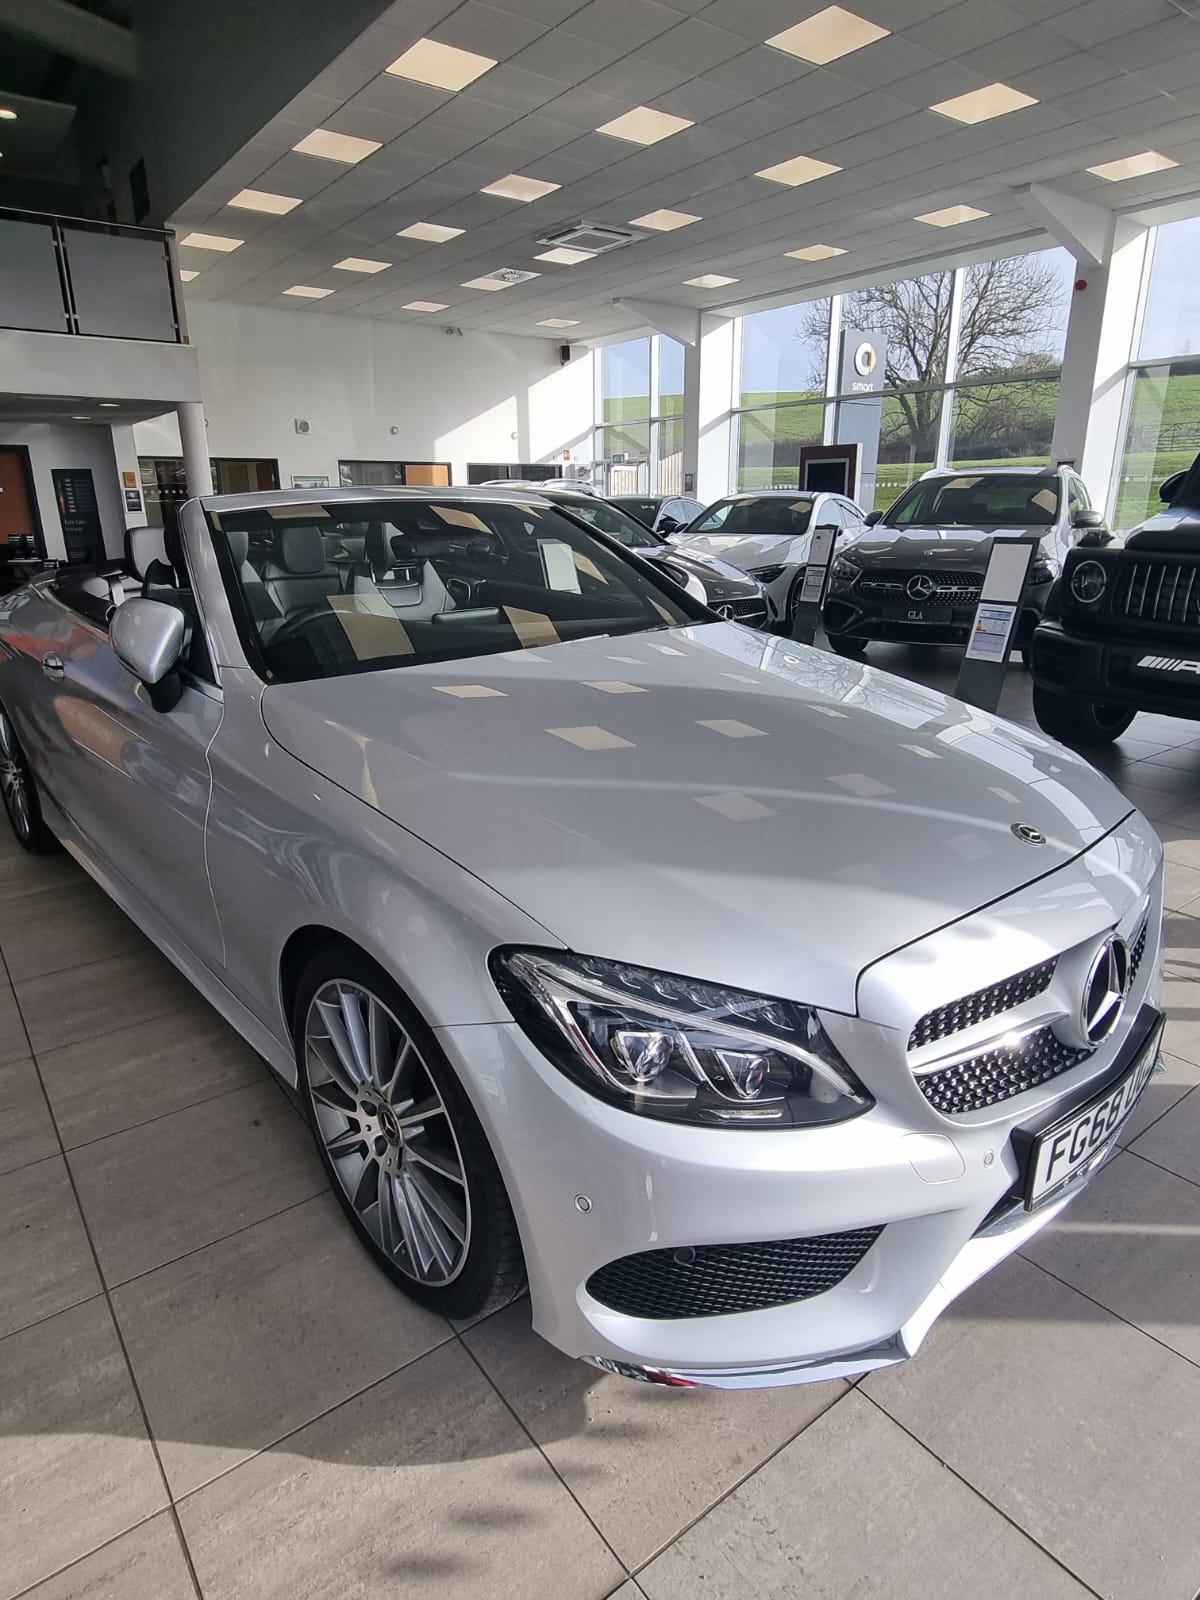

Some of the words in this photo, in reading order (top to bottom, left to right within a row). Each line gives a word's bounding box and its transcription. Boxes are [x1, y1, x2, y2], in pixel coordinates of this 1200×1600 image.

[852, 382, 873, 392] smart
[907, 610, 923, 620] GLA
[1046, 1086, 1125, 1183] FG68
